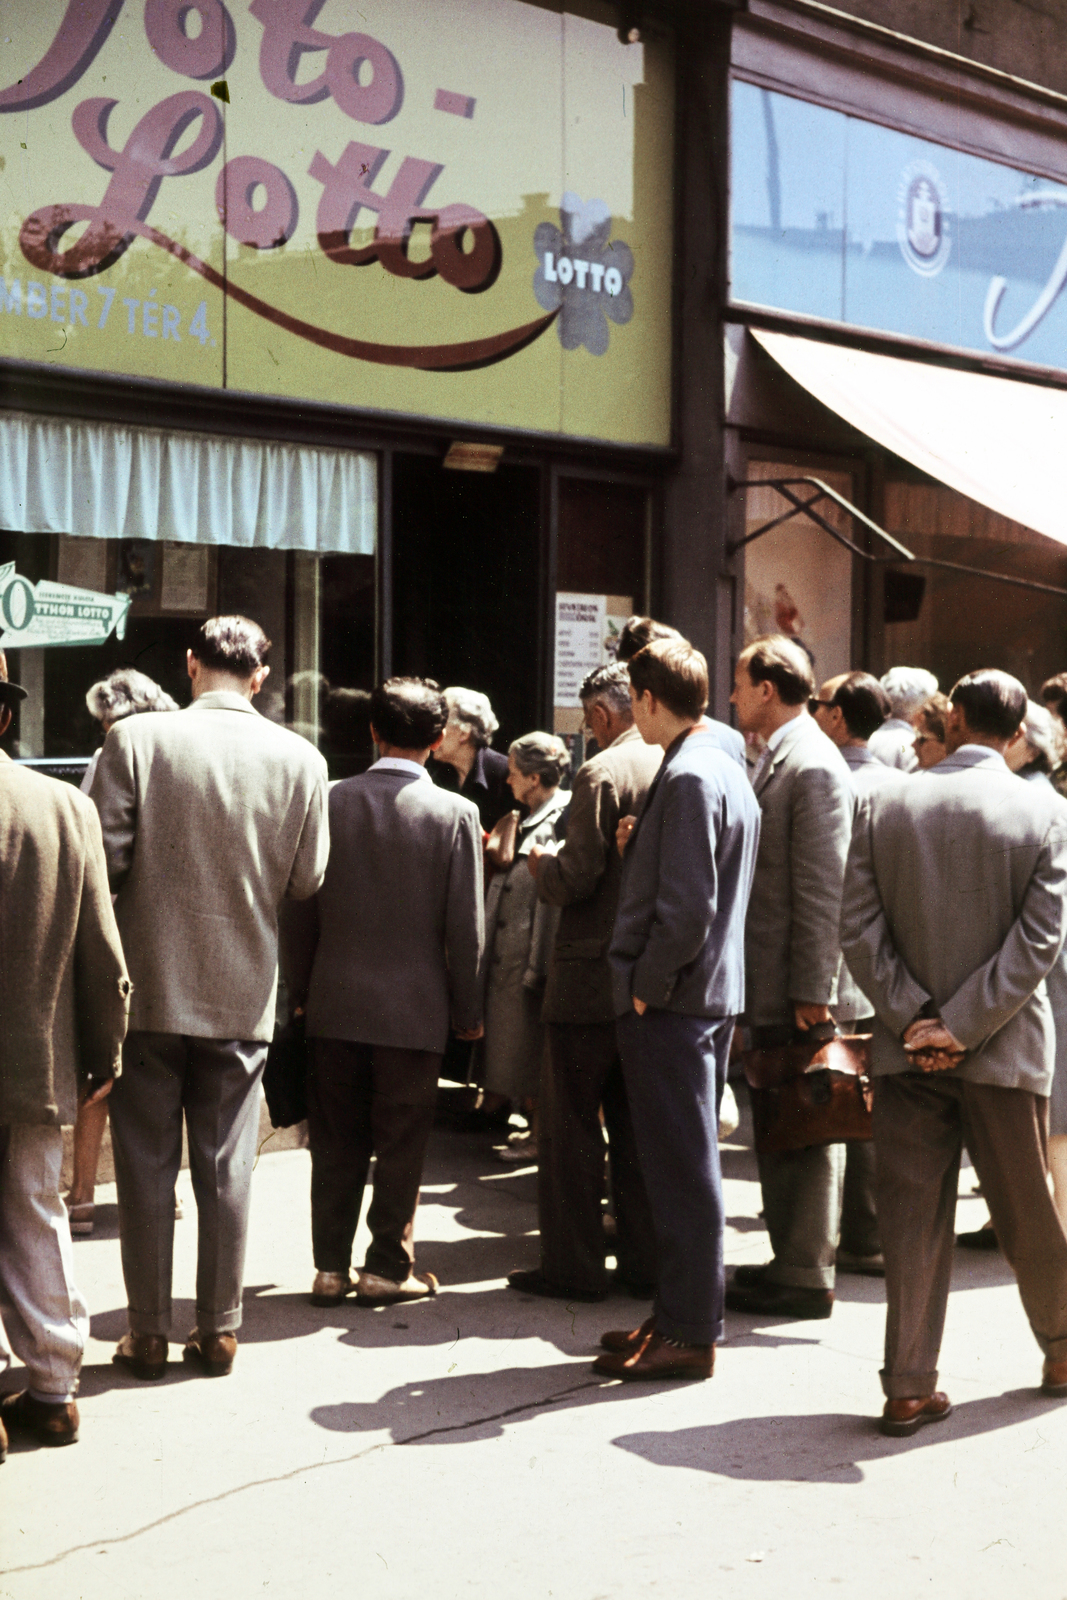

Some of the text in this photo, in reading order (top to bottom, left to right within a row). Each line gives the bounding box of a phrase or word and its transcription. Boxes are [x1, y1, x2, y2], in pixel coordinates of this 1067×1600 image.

[19, 90, 561, 371] Lotto
[544, 252, 623, 296] LOTTO
[97, 286, 116, 329] 7
[123, 288, 182, 342] TÉR
[78, 606, 110, 620] LOTTO
